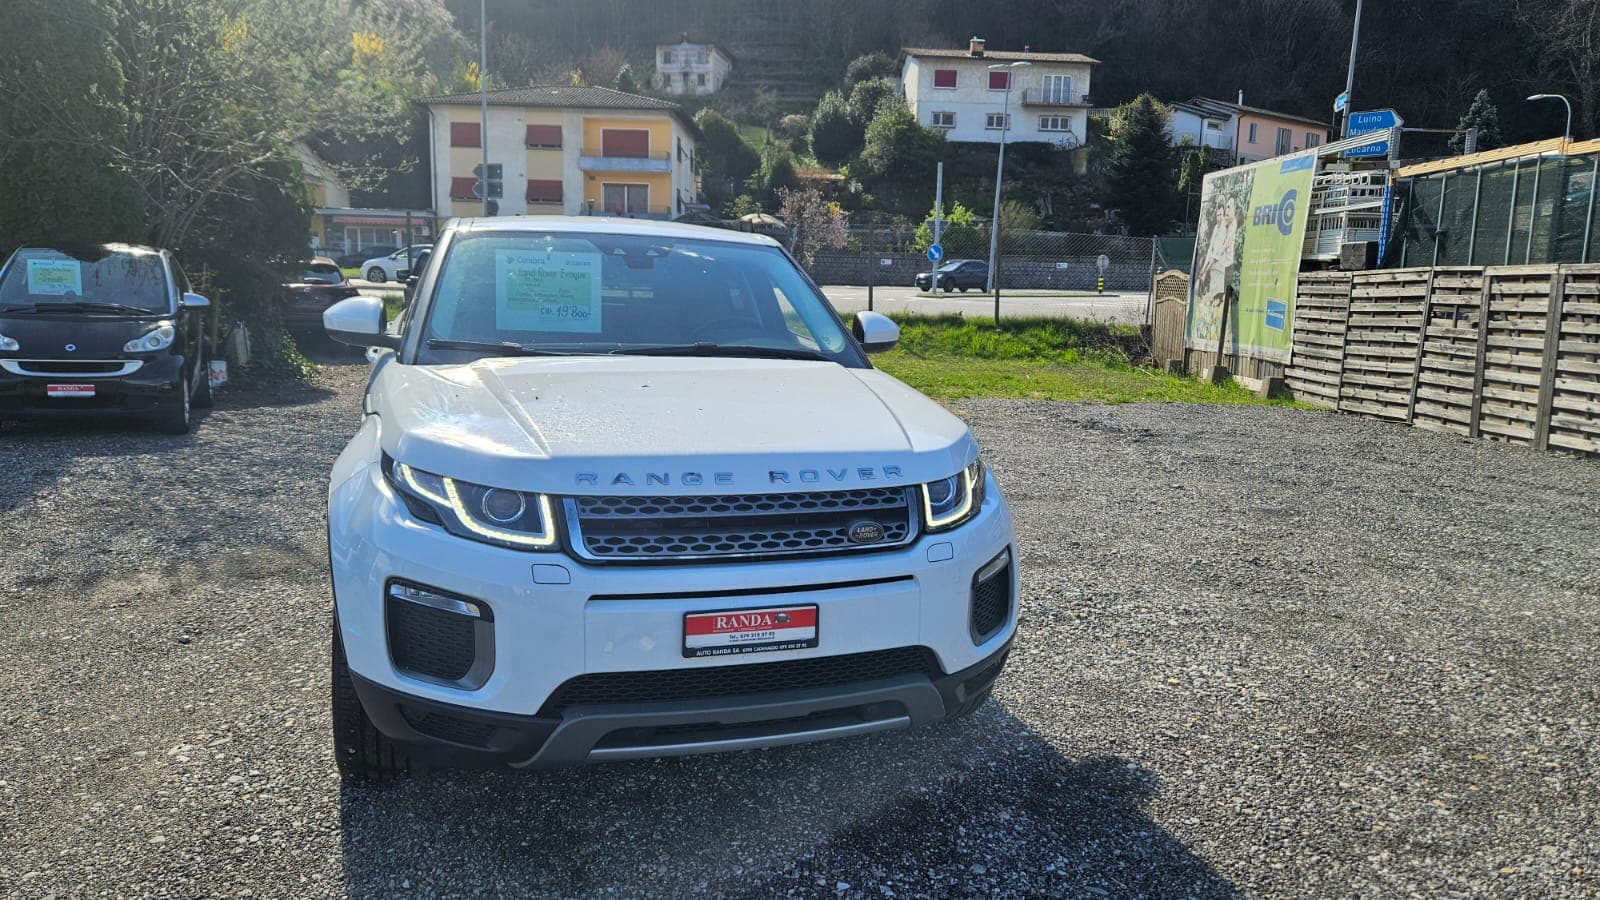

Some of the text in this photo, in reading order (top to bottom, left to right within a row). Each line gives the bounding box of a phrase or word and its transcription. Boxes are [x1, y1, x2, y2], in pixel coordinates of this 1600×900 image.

[1358, 115, 1382, 124] Luino
[560, 268, 587, 281] Evoque
[574, 464, 903, 487] RANGE ROVER
[716, 614, 772, 629] RANDA
[712, 648, 732, 656] RANDA
